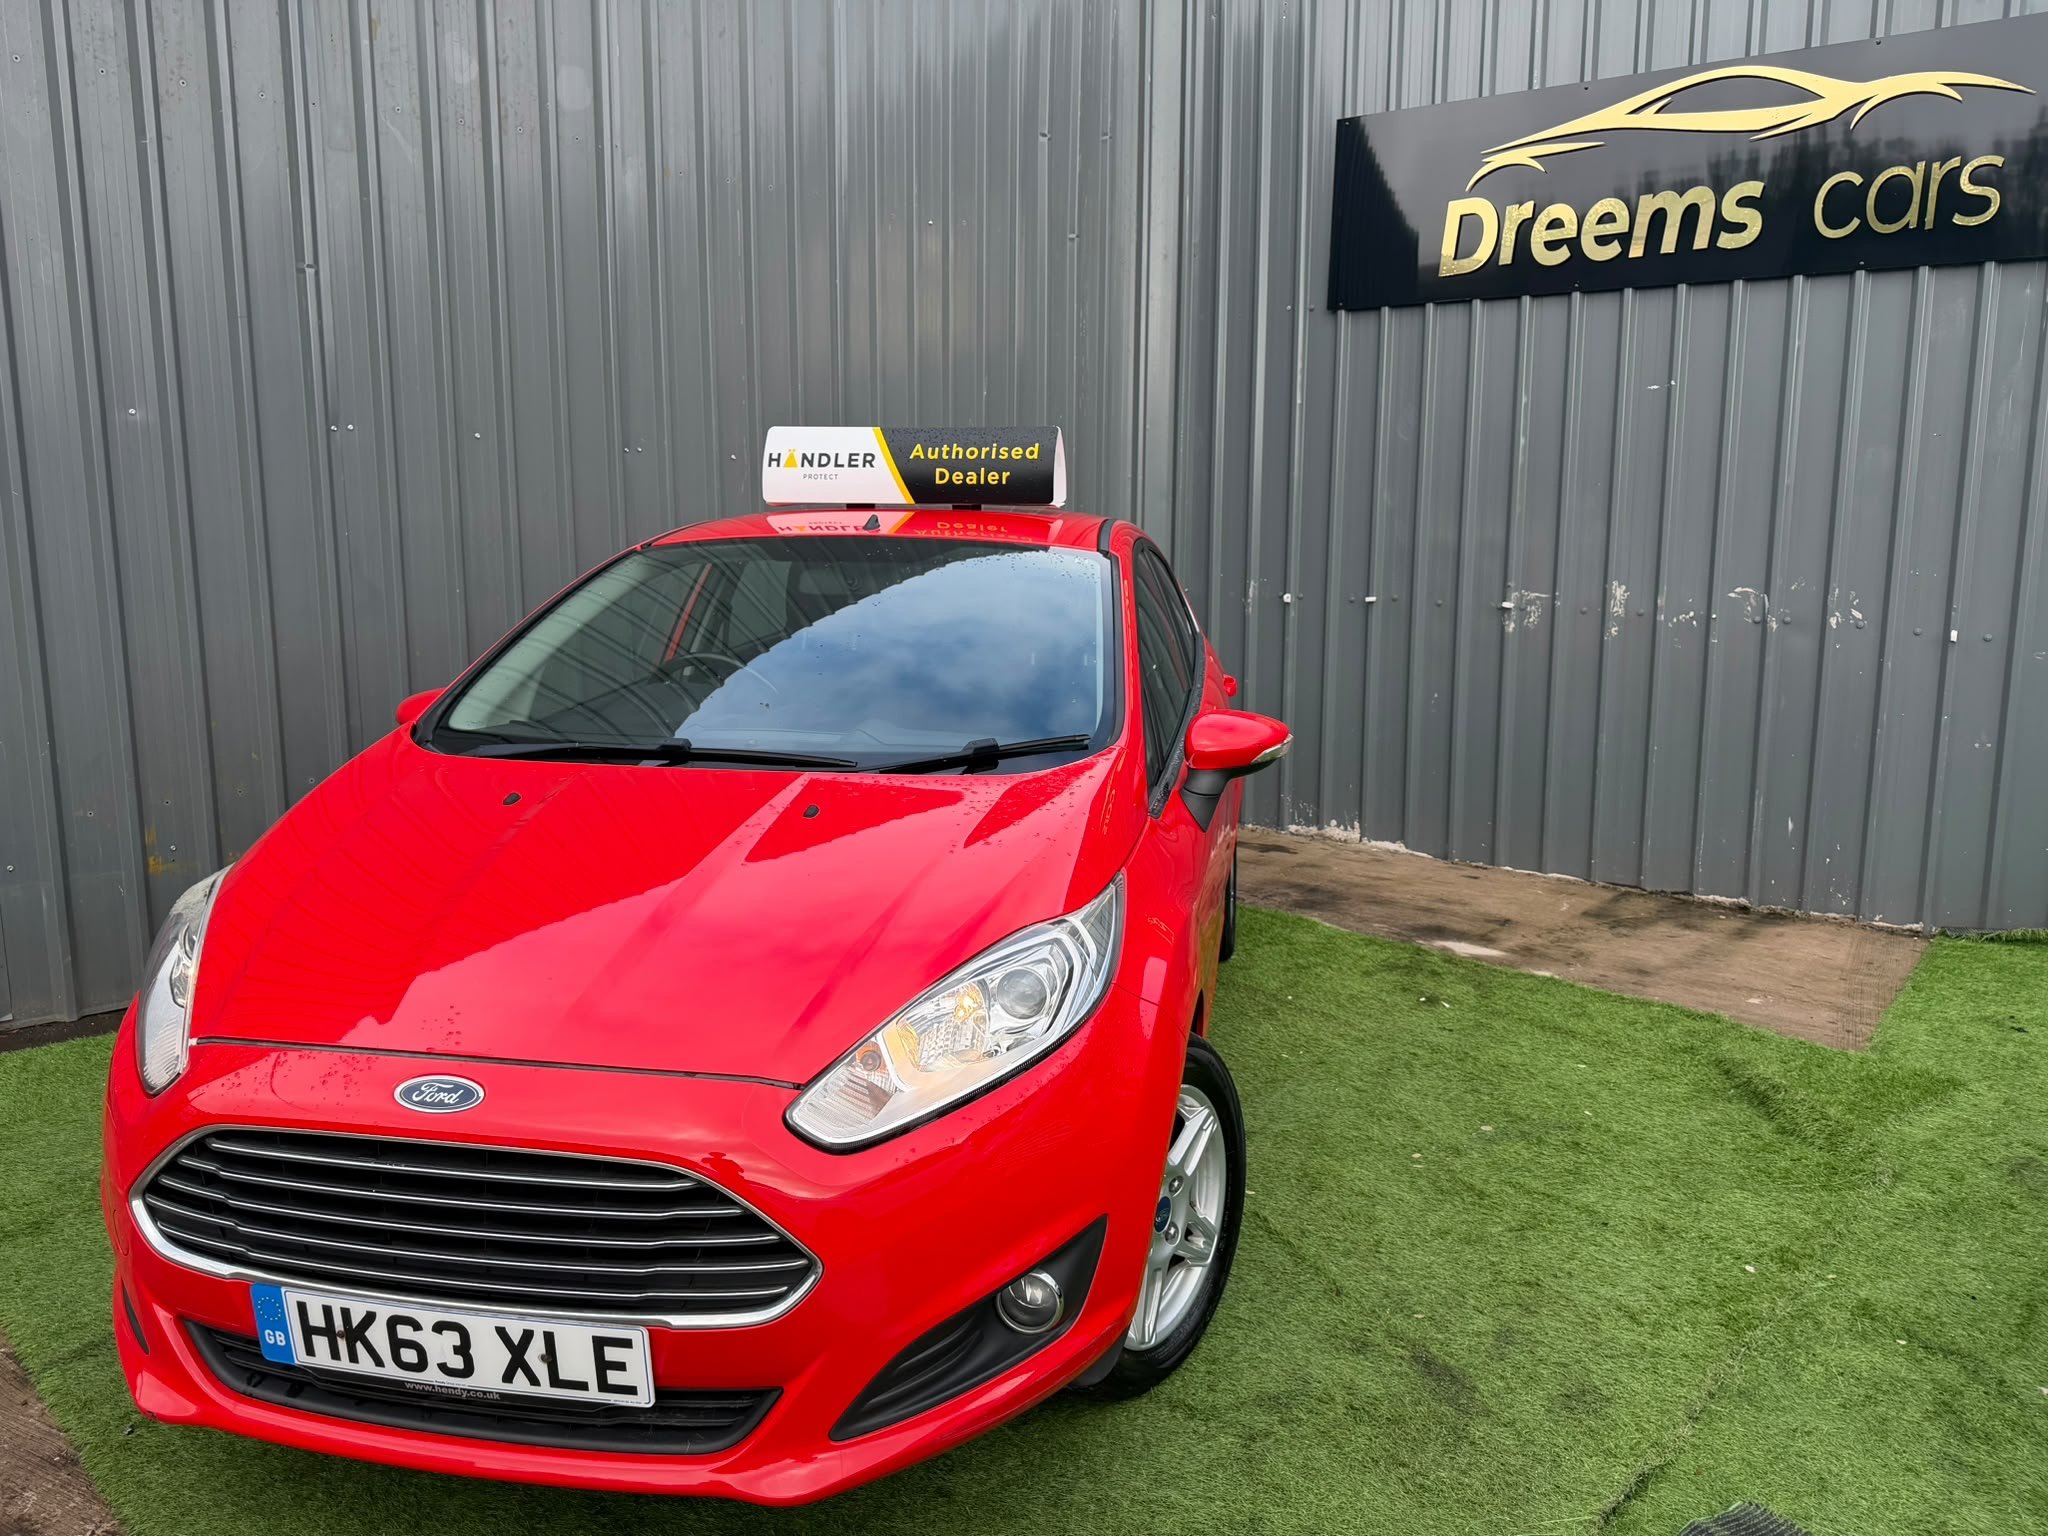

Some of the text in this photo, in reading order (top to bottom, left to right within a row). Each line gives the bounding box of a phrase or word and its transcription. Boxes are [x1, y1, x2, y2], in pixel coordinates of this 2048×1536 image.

[1438, 154, 2006, 278] Dreems cars
[768, 449, 876, 468] HÄNDLER
[909, 442, 1040, 461] Authorised
[935, 467, 1011, 485] Dealer
[412, 1082, 464, 1104] Ford
[264, 1329, 287, 1347] GB
[296, 1301, 639, 1396] HK63 XLE
[404, 1381, 501, 1400] www.hendy.co.uk
